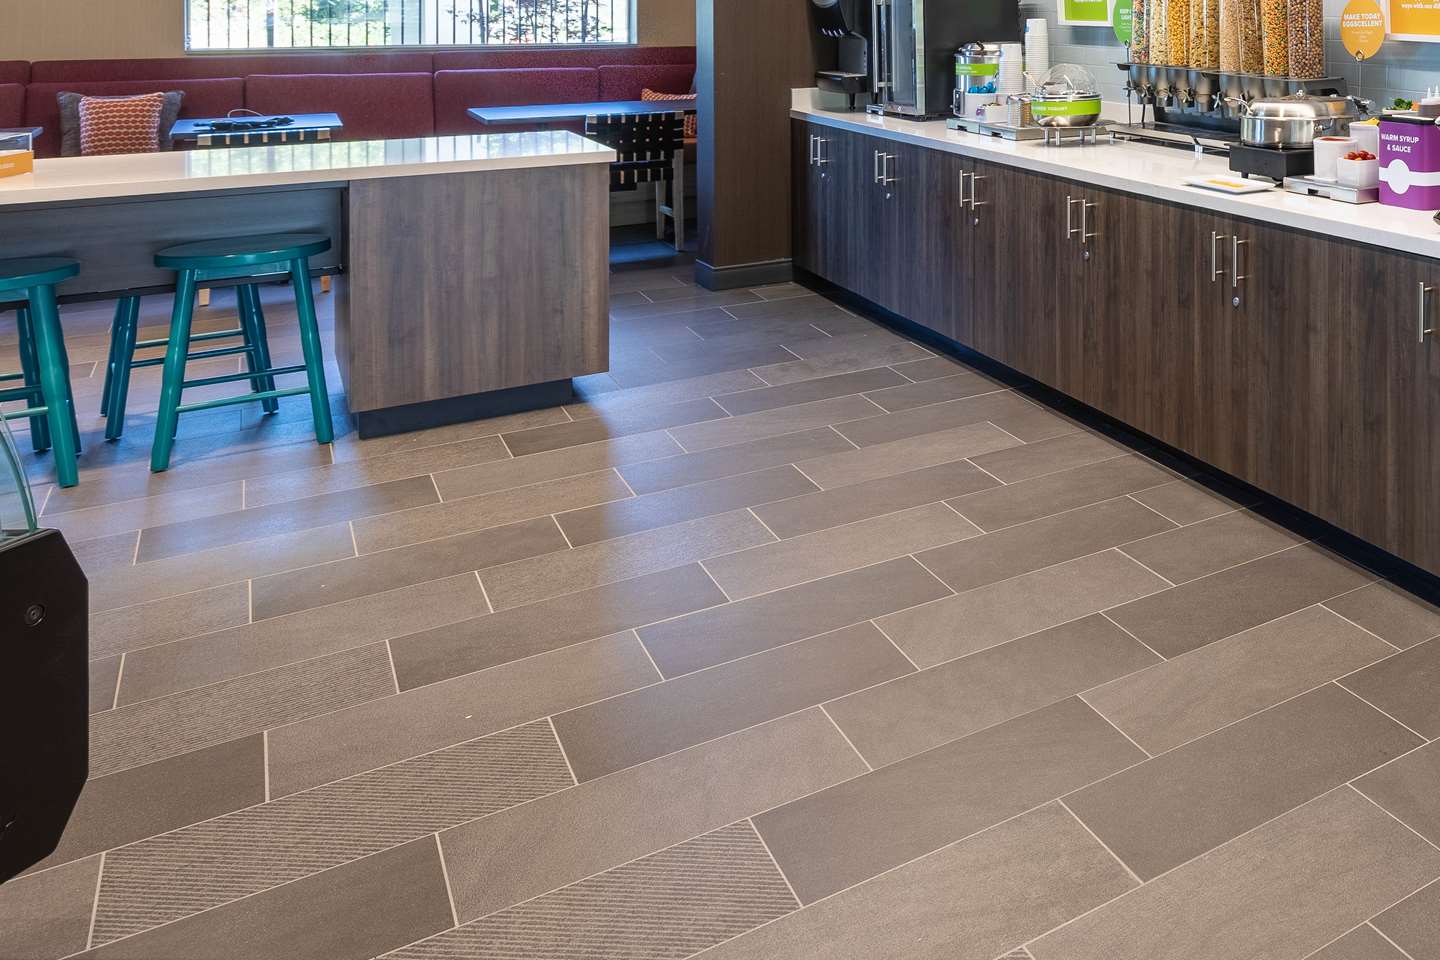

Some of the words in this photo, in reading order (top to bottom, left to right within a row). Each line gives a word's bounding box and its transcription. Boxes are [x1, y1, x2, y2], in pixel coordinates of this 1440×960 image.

[1381, 133, 1399, 142] WARM
[1399, 135, 1420, 144] SYRUP
[1392, 145, 1412, 153] SAUCE
